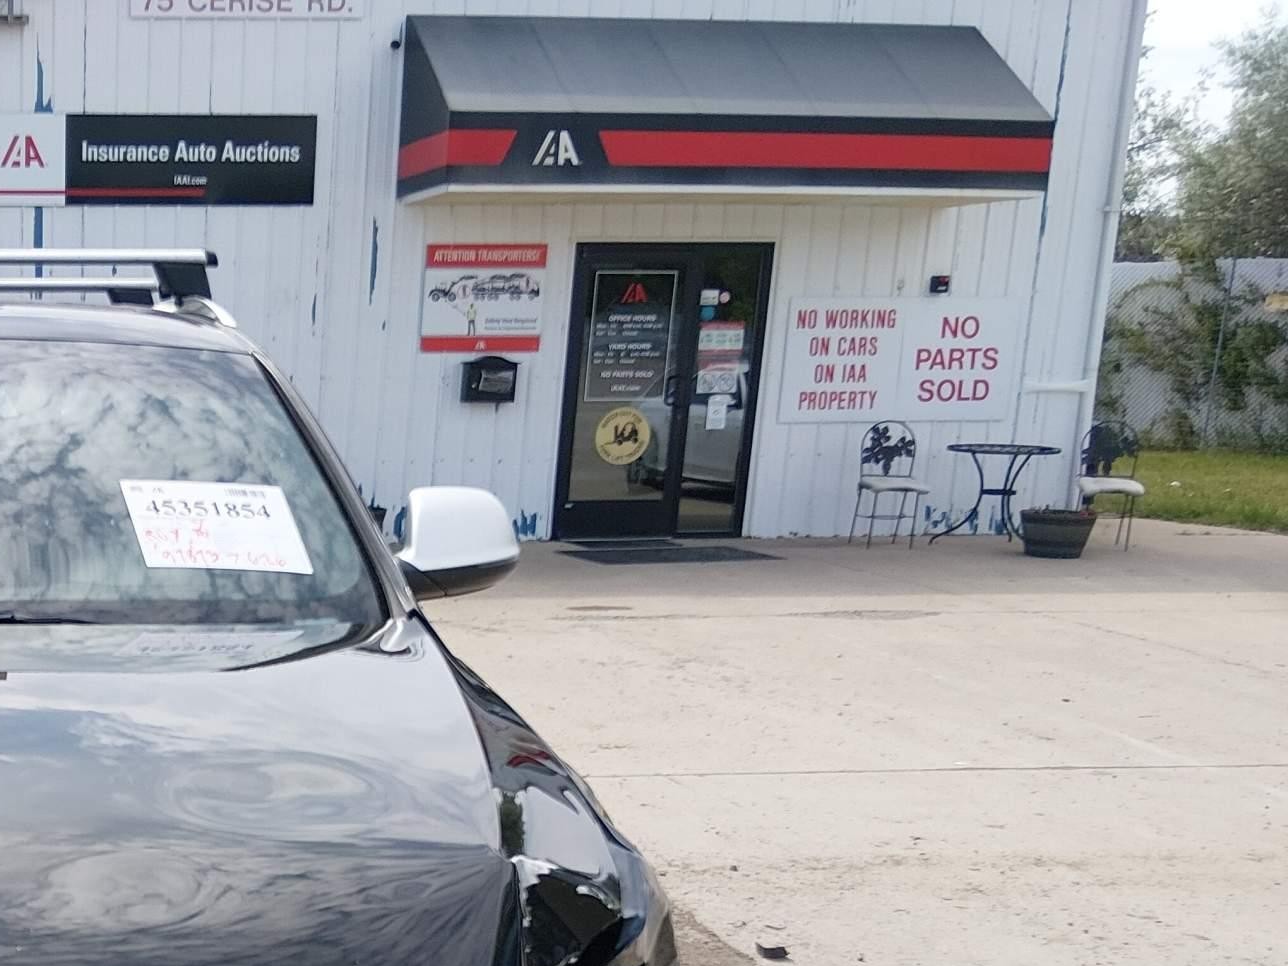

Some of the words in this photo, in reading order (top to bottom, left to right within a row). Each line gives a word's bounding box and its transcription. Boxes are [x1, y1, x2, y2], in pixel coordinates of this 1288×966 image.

[81, 139, 170, 163] Insurance
[174, 139, 217, 163] Auto
[220, 139, 300, 163] Auctions
[173, 174, 208, 186] IAAI.com
[433, 249, 476, 263] ATTENTION
[796, 309, 818, 329] NO
[825, 309, 897, 329] WORKING
[941, 316, 980, 339] NO
[809, 337, 830, 357] ON
[837, 336, 878, 356] CARS
[915, 348, 999, 370] PARTS
[814, 364, 834, 384] ON
[841, 364, 867, 383] IAA
[917, 379, 990, 402] SOLD
[798, 391, 878, 411] PROPERTY
[146, 500, 270, 519] 45351854
